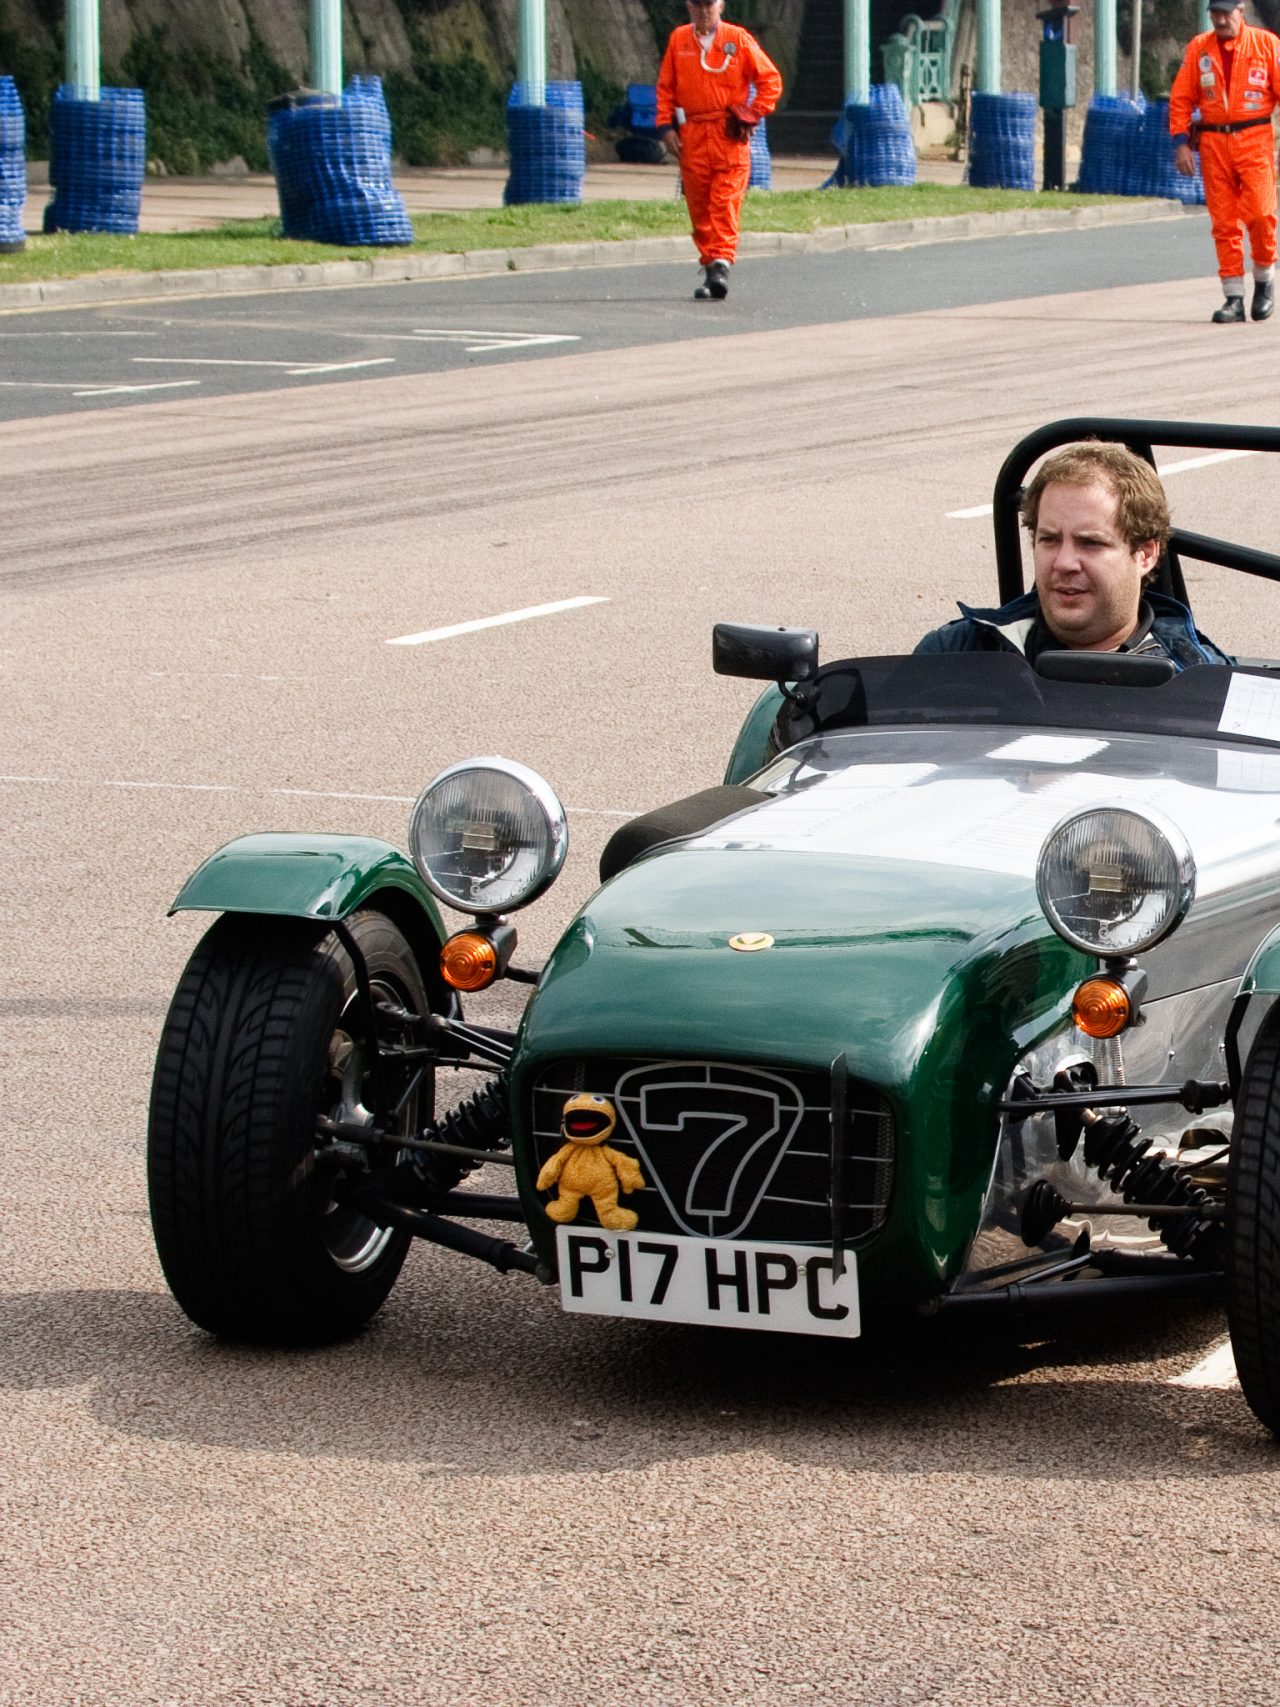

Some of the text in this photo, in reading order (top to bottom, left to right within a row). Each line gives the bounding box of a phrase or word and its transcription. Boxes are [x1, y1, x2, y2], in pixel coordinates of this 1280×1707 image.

[640, 1082, 780, 1216] 7
[567, 1235, 849, 1321] P17 HPC
